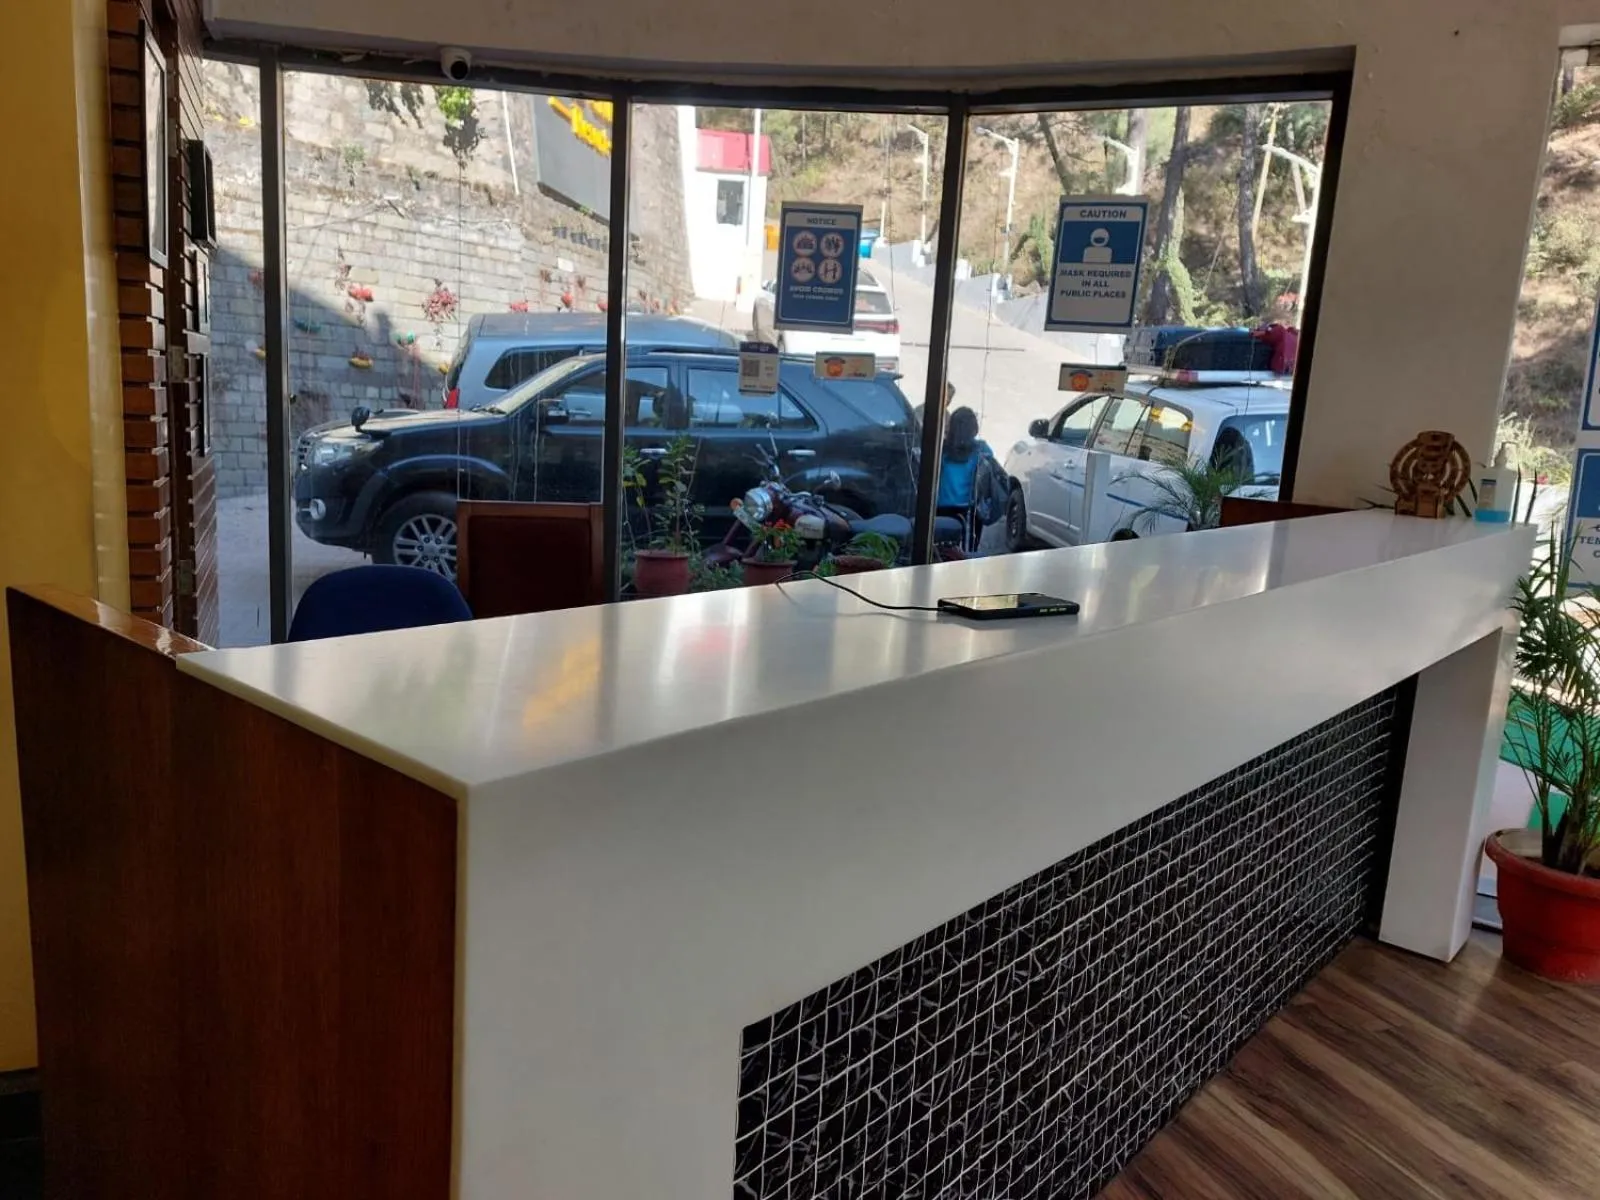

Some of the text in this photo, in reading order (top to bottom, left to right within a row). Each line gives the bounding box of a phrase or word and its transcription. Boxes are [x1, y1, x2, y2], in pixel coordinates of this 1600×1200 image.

[1080, 209, 1127, 219] CAUTION
[807, 217, 837, 226] NOTICE
[1059, 269, 1132, 278] MASK REQUIRED
[1081, 280, 1109, 288] IN ALL
[1060, 289, 1126, 299] PUBLIC PLACES
